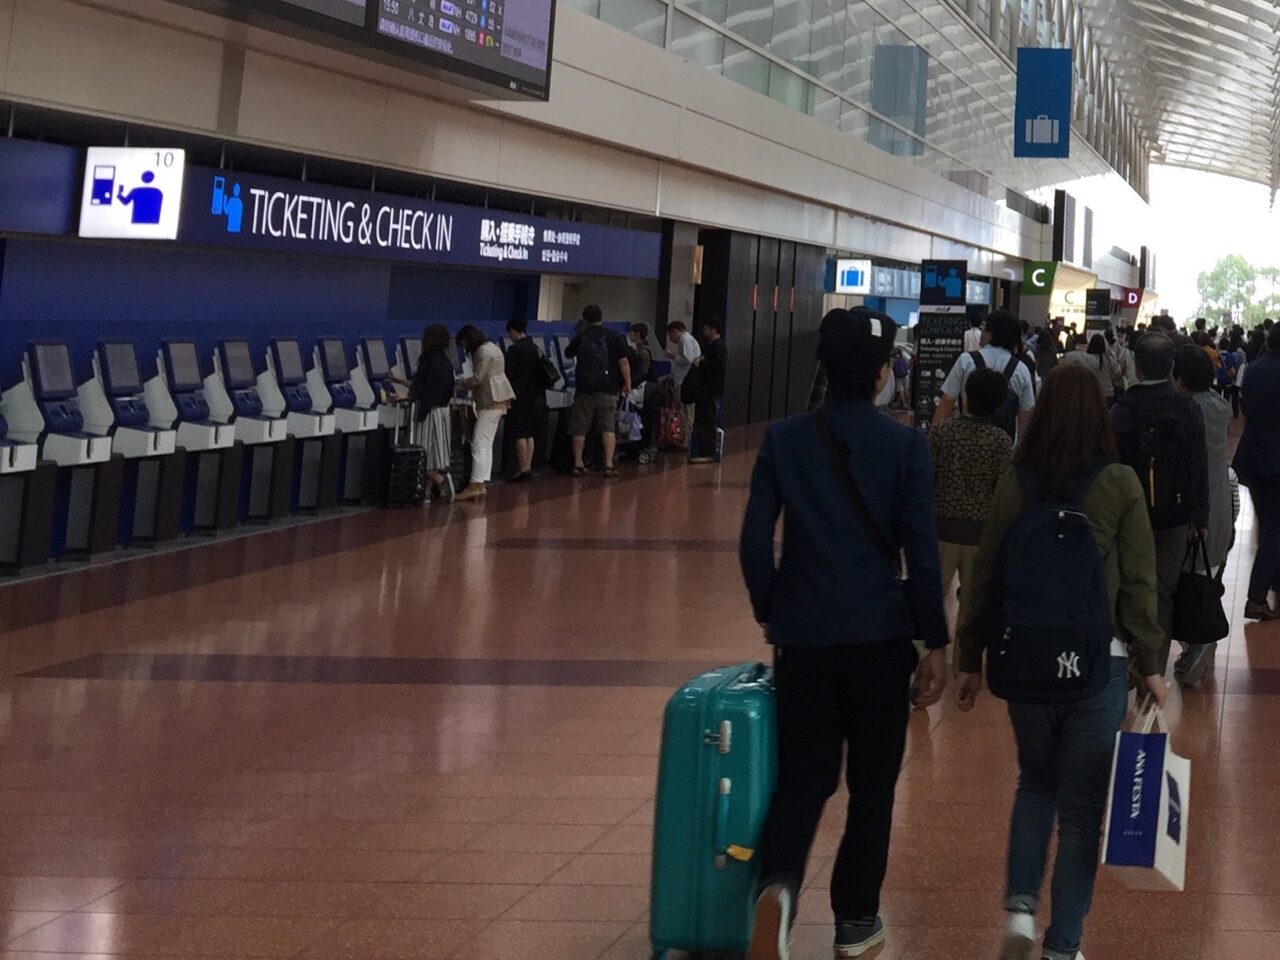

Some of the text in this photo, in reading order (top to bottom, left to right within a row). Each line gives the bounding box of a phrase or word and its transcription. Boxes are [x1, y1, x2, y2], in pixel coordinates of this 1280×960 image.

[155, 151, 174, 168] 10
[250, 189, 453, 252] TICKETING & CHECK IN
[480, 242, 504, 262] Ticketing
[508, 245, 523, 260] Check
[522, 246, 528, 260] In
[1032, 268, 1046, 287] C
[1065, 291, 1074, 305] C
[1128, 292, 1138, 304] D
[1056, 651, 1081, 678] NY
[1130, 749, 1147, 819] ANA FESTA
